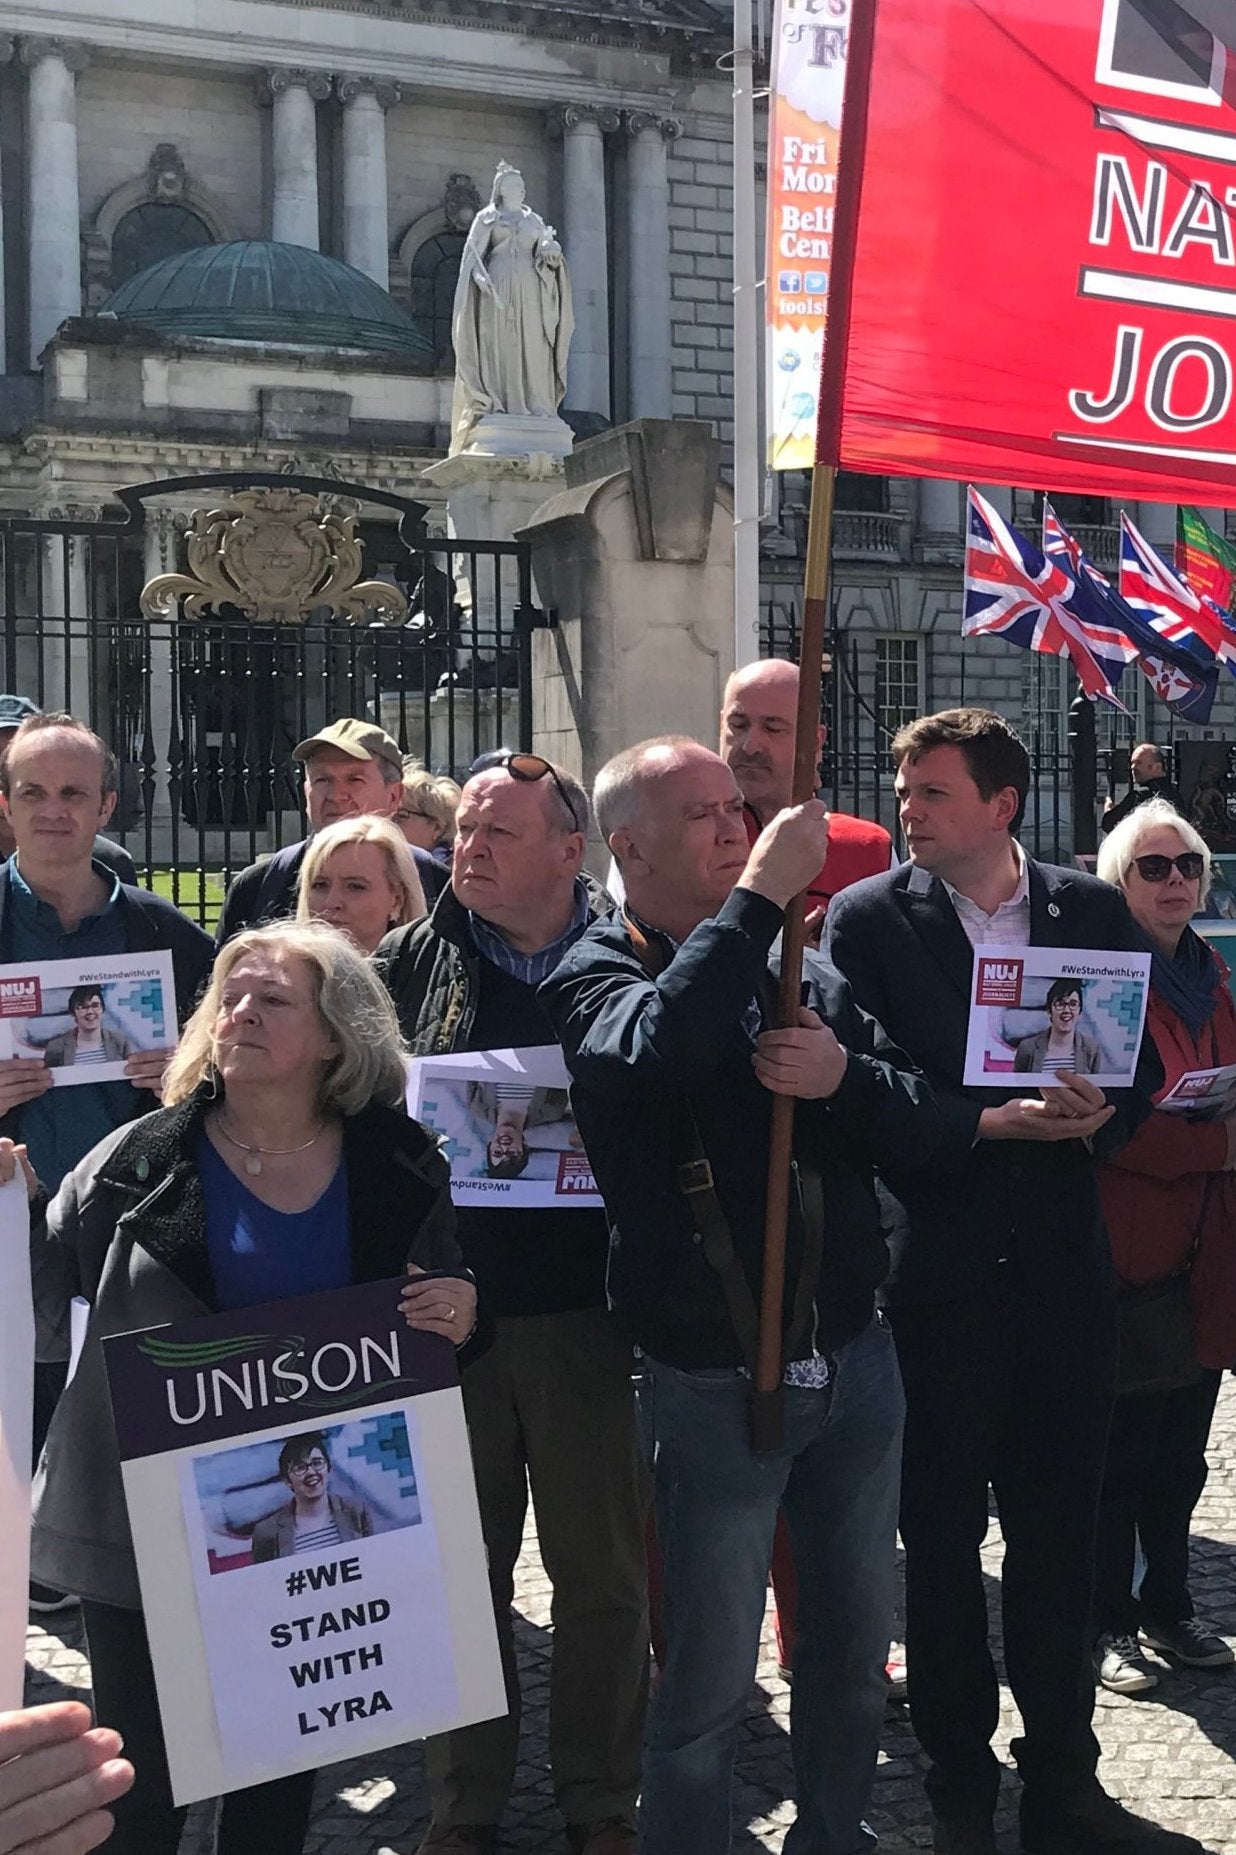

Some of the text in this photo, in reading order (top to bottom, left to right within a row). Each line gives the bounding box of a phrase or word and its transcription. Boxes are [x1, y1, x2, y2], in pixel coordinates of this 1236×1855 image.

[808, 24, 848, 69] F
[782, 136, 827, 165] Fri
[780, 232, 832, 259] Cen
[79, 968, 160, 983] #WeStandwithLyra
[983, 963, 1019, 980] NUJ
[1061, 964, 1145, 979] #WeStandwithLyra
[0, 981, 35, 997] NUJ
[166, 1330, 401, 1426] UNISON
[286, 1557, 362, 1597] #WE
[269, 1598, 391, 1649] STAND
[289, 1643, 383, 1688] WITH
[297, 1689, 393, 1736] LYRA
